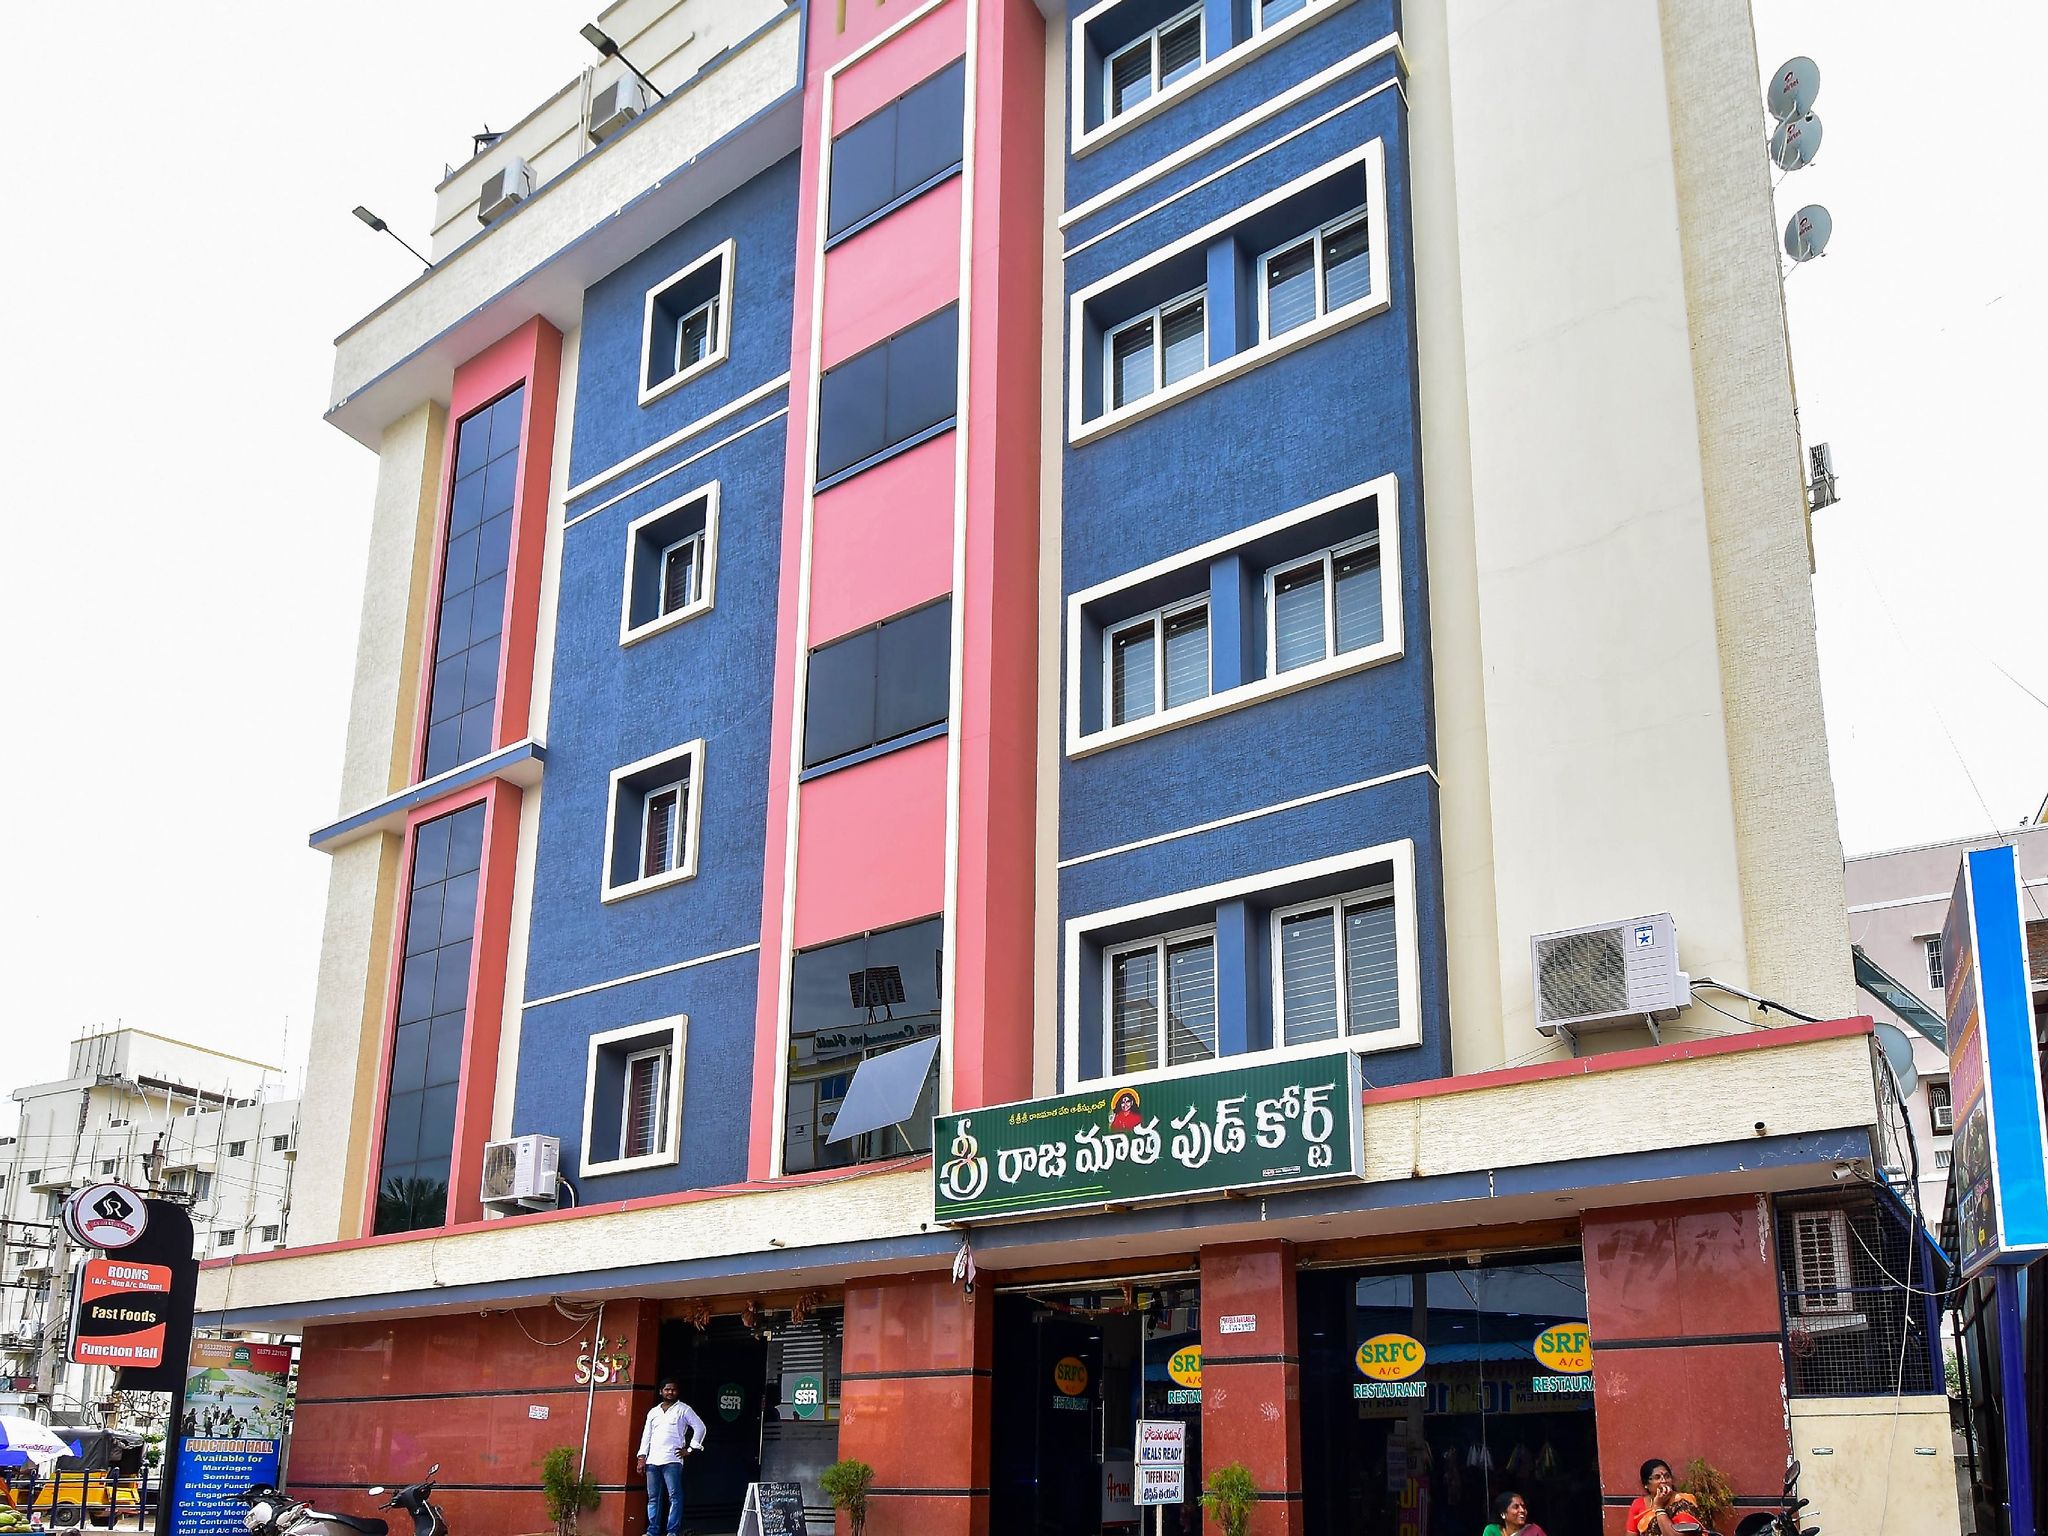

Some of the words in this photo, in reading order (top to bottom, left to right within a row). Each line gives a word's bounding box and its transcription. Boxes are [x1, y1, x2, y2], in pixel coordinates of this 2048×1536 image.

[939, 1118, 988, 1200] శ్రీ
[108, 1265, 149, 1281] ROOMS
[92, 1306, 119, 1320] Fast
[120, 1308, 157, 1323] Foods
[81, 1342, 133, 1357] Function
[135, 1345, 159, 1359] Hall
[1361, 1342, 1417, 1364] SRFC
[574, 1353, 631, 1384] SSR
[1558, 1358, 1584, 1367] A/C
[1378, 1367, 1400, 1375] A/C
[795, 1389, 817, 1405] SSR
[1353, 1382, 1427, 1398] RESTAURANT
[720, 1395, 741, 1410] SSR
[185, 1438, 245, 1453] FUNCTION
[245, 1439, 273, 1453] HALL
[194, 1454, 245, 1462] Available
[1142, 1447, 1162, 1460] MEALS
[1163, 1447, 1182, 1460] READY
[1145, 1470, 1163, 1484] TIFFEN
[1163, 1470, 1181, 1483] READY
[185, 1482, 221, 1490] Birthday
